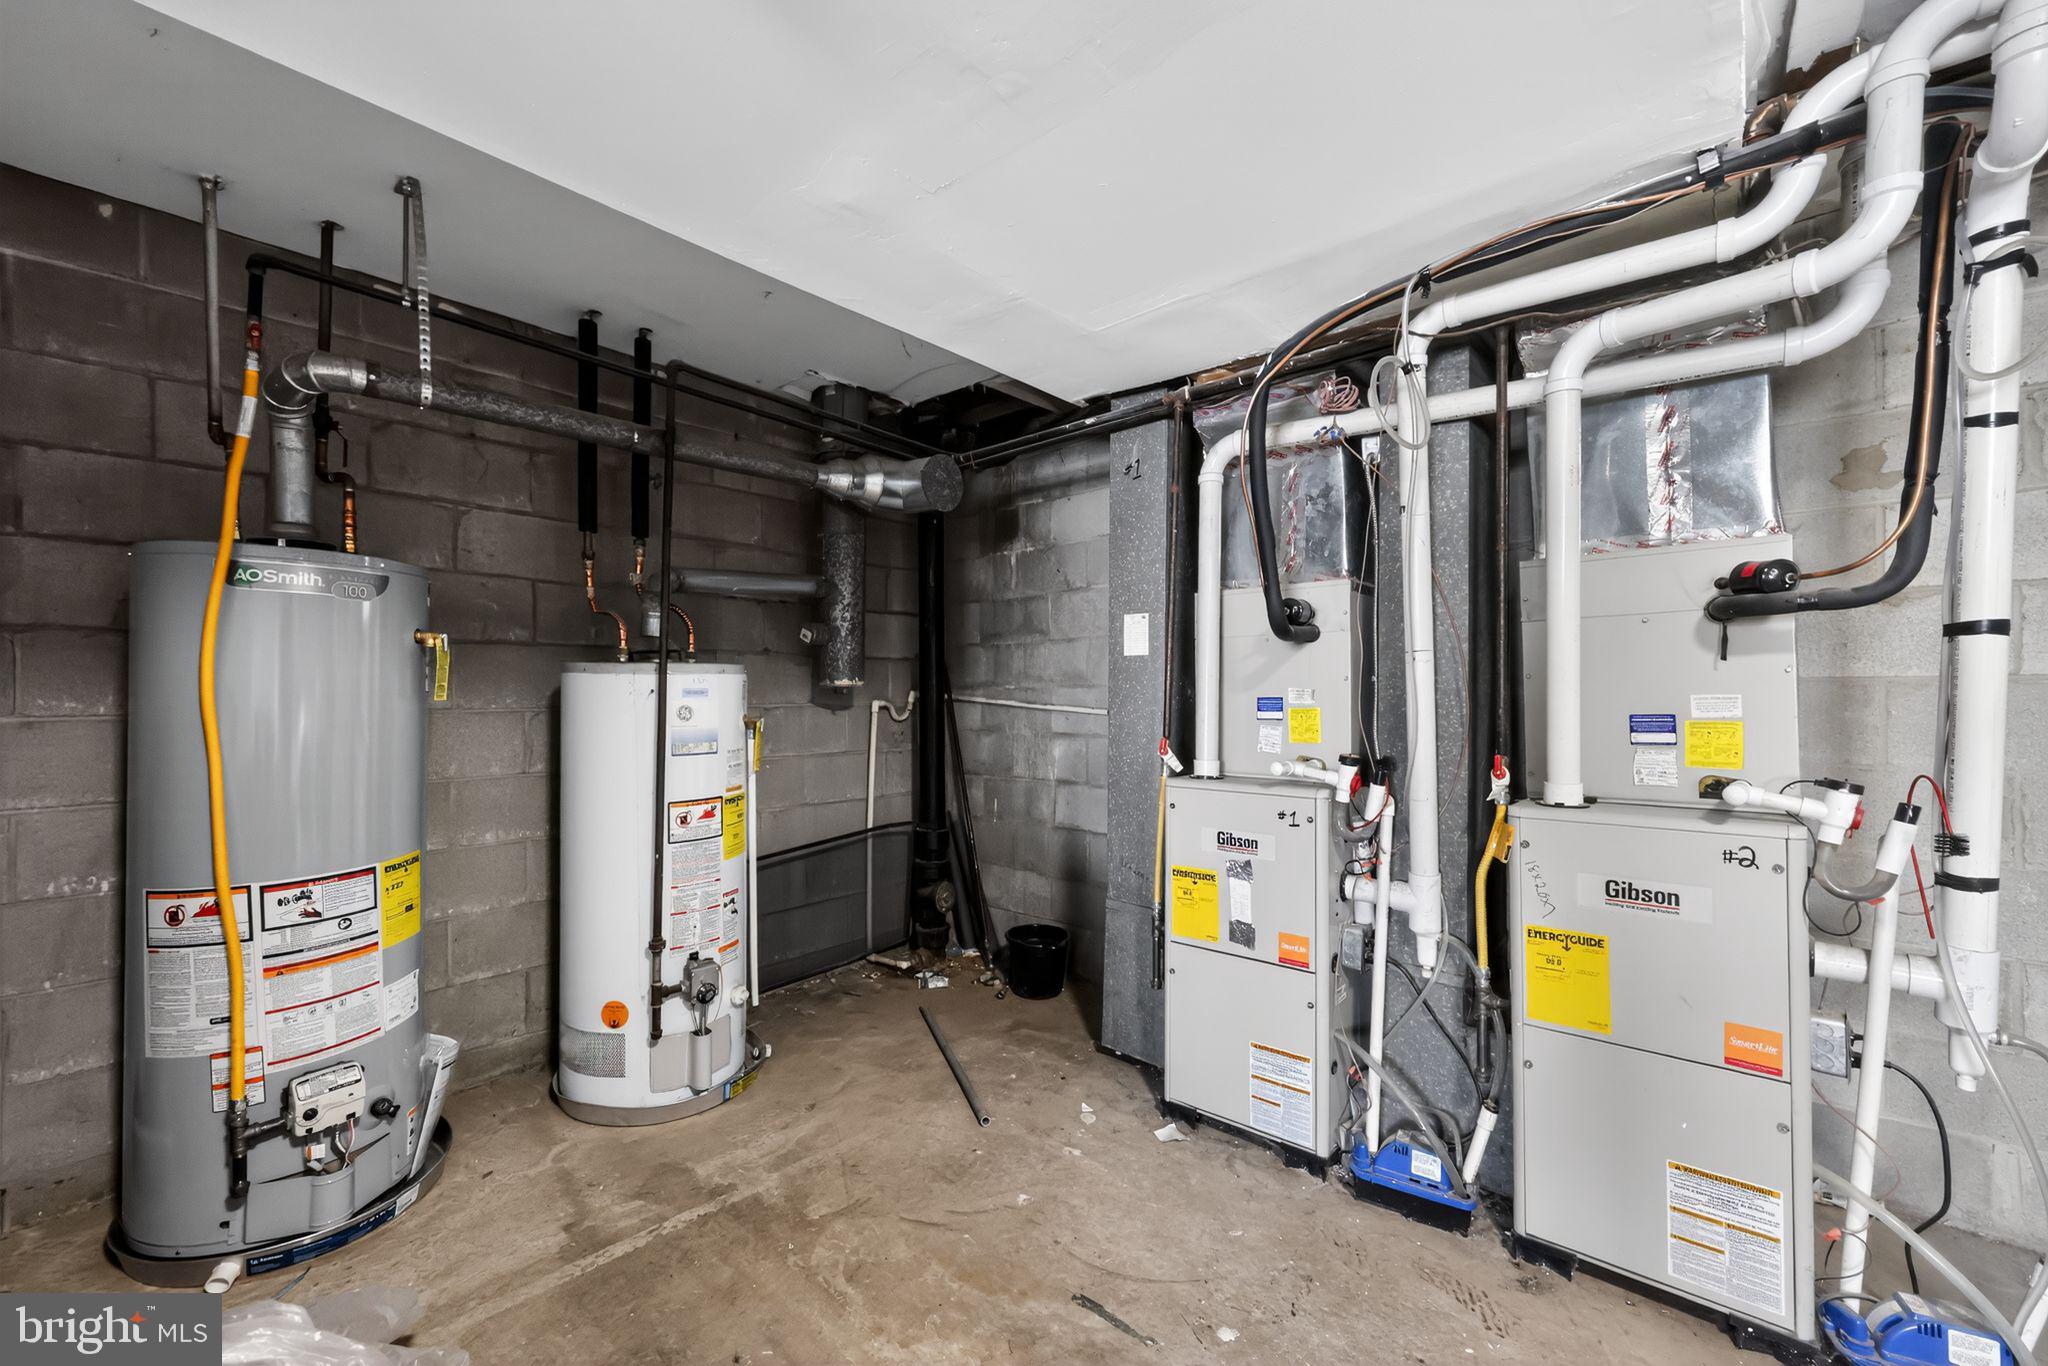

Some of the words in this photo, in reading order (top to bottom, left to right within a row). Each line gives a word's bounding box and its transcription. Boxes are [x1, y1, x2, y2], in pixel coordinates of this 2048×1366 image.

[343, 584, 367, 598] 100
[1277, 810, 1300, 827] #1
[1217, 831, 1258, 849] Gibson
[1722, 846, 1759, 870] #2
[1605, 880, 1680, 907] Gibson
